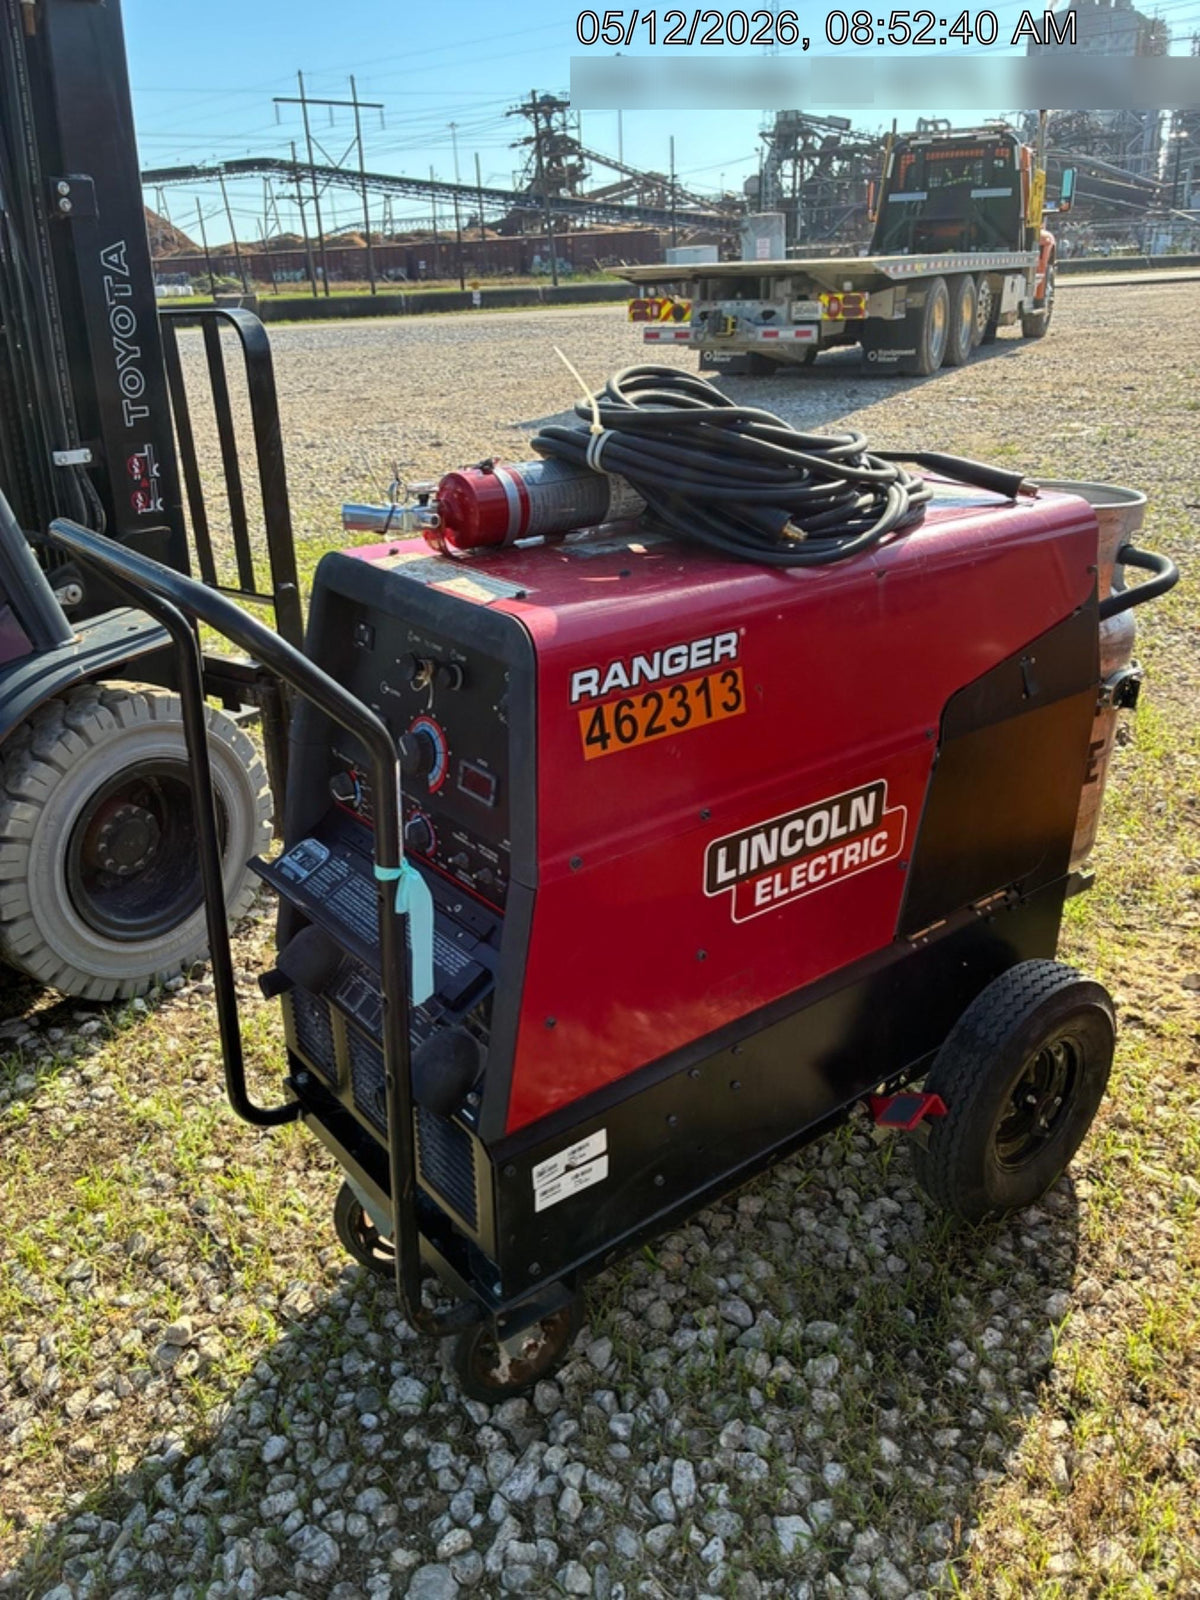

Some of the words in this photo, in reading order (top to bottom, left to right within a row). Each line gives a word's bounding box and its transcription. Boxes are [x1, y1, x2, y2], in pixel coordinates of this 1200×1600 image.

[100, 240, 150, 428] TOYOTA
[569, 630, 740, 704] RANGER
[584, 668, 743, 751] 462313
[715, 791, 877, 885] LINCOLN
[754, 830, 889, 907] ELECTRIC
